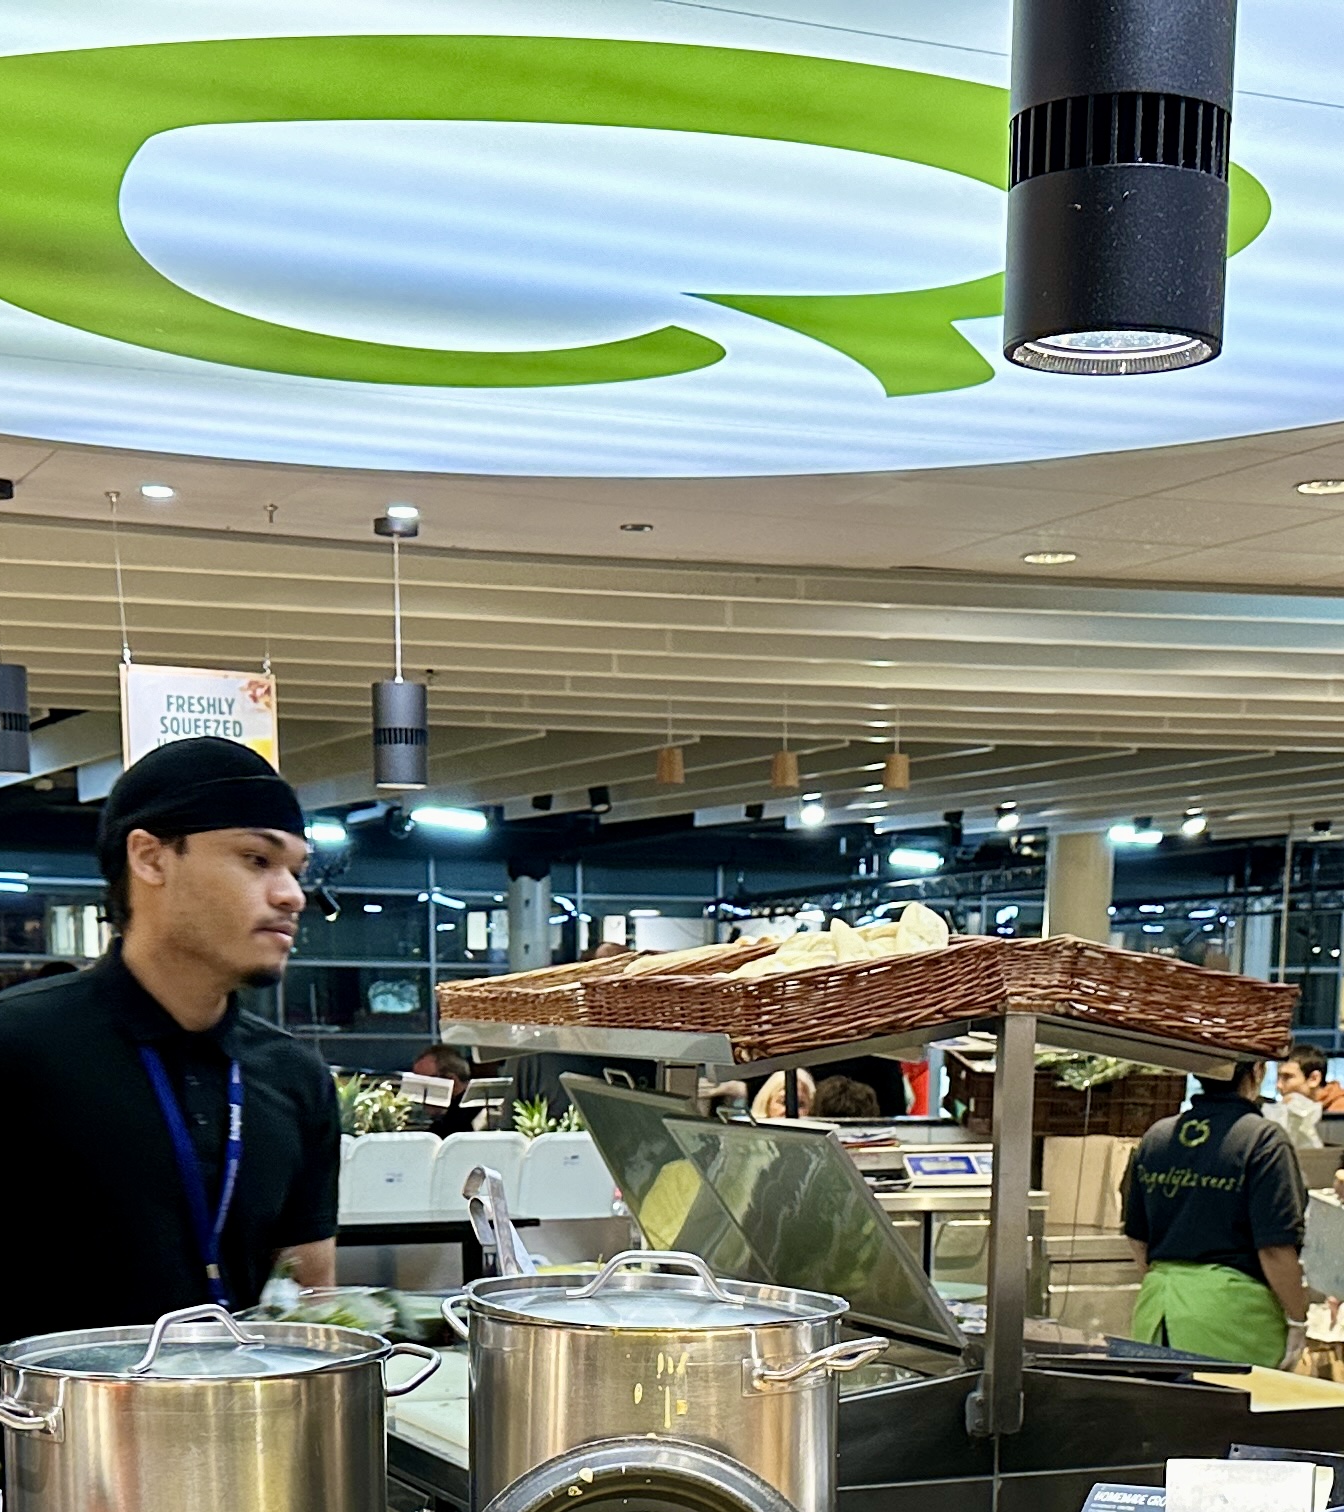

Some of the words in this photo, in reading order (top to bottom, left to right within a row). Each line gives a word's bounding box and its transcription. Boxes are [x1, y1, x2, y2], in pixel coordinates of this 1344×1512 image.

[166, 694, 235, 716] FRESHLY
[160, 716, 243, 738] SQUEEZED
[1094, 1491, 1148, 1505] HOMEMADE
